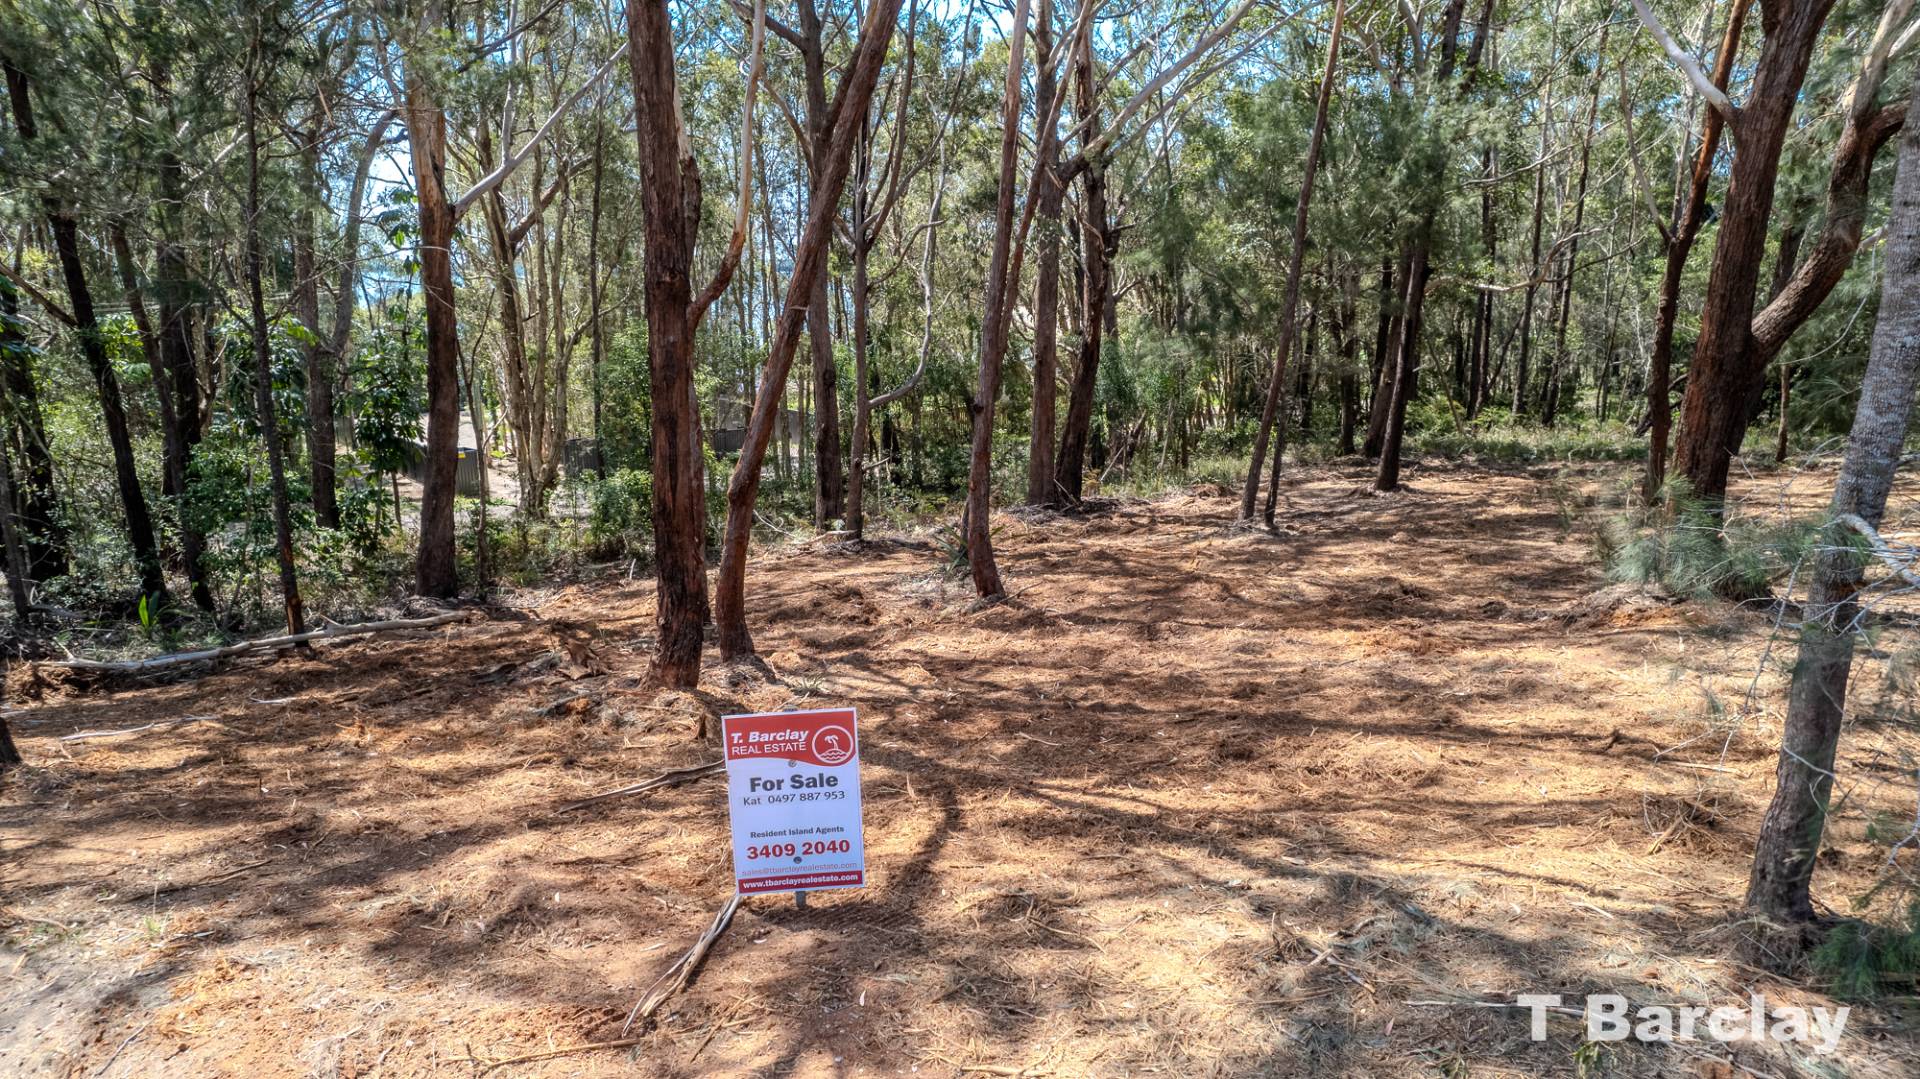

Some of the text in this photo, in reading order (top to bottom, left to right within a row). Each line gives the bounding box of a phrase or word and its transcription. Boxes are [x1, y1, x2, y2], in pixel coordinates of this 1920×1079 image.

[730, 729, 809, 744] T. Barclay
[731, 742, 807, 756] REAL ESTATE
[749, 773, 839, 792] For Sale
[743, 790, 845, 806] Kat 0497 887 953
[750, 826, 845, 838] Resident Island Agents
[746, 839, 850, 860] 3409 2040
[743, 874, 858, 889] www.tbarclayrealestate.com
